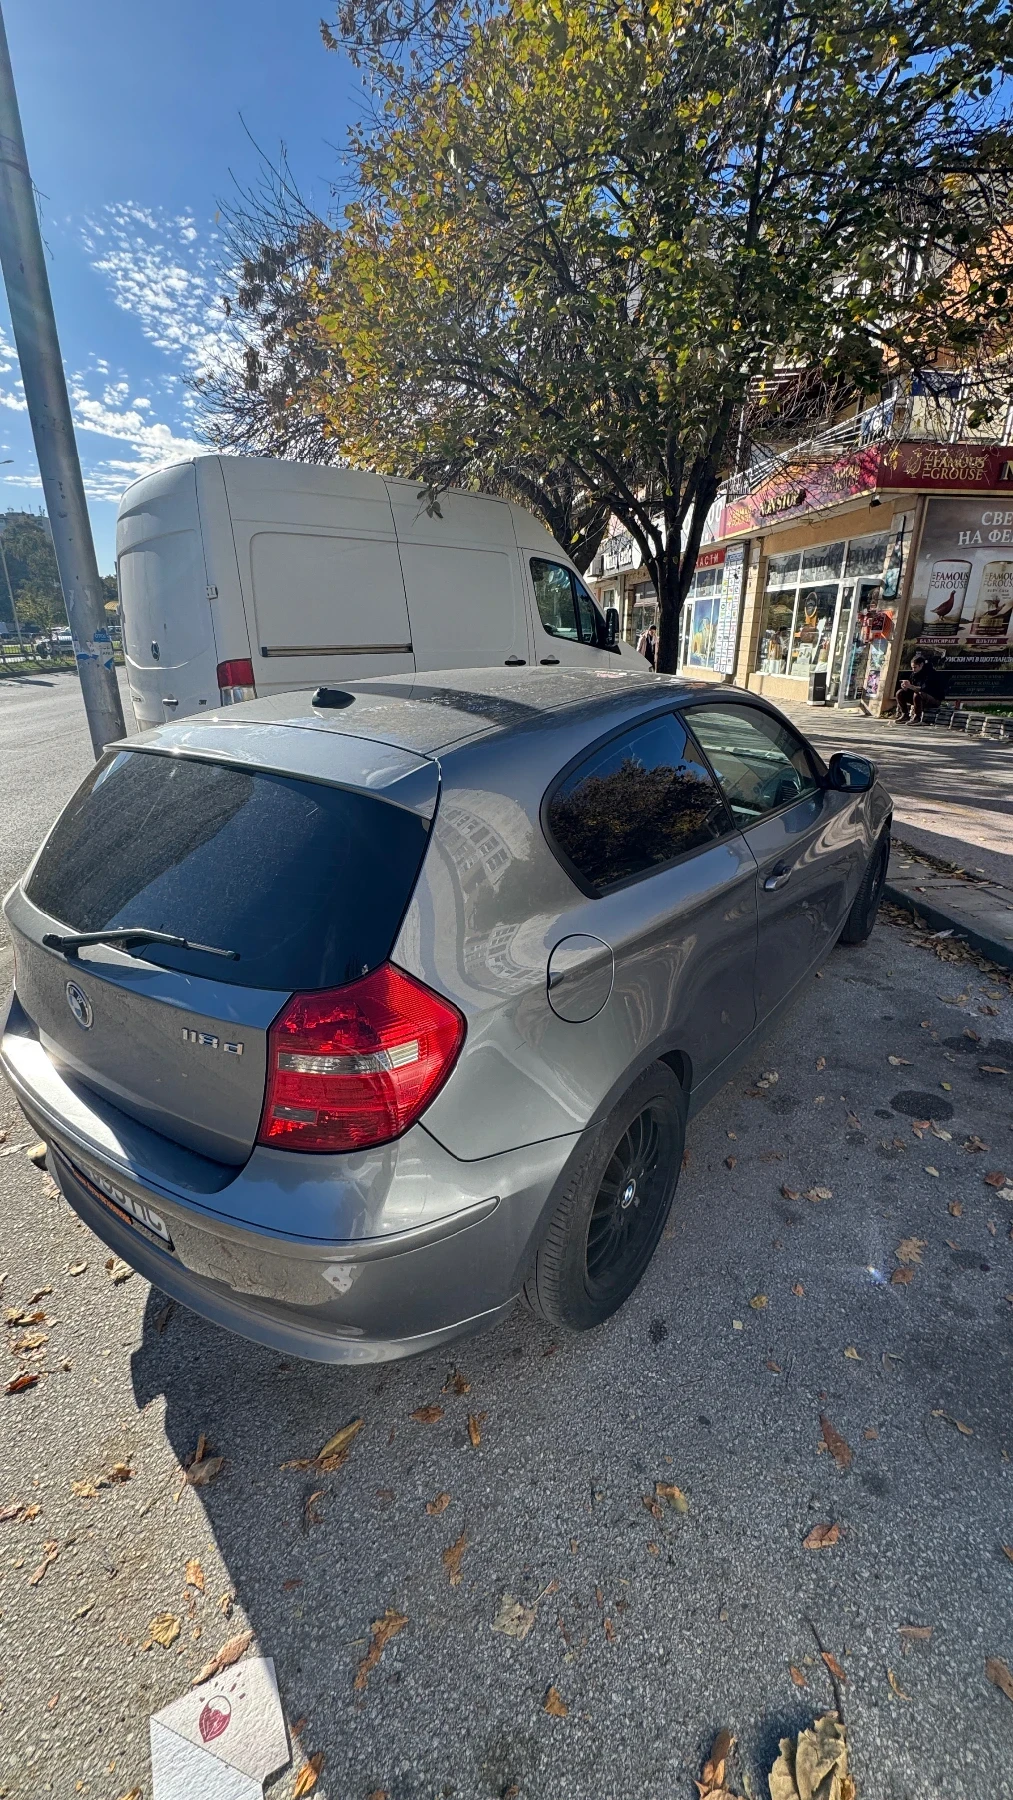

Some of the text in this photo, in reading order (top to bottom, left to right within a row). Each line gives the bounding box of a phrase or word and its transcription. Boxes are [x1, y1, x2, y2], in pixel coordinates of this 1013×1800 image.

[931, 467, 984, 480] GROUSE
[958, 529, 1013, 546] НА ФЕ
[935, 571, 969, 581] FAMOUS
